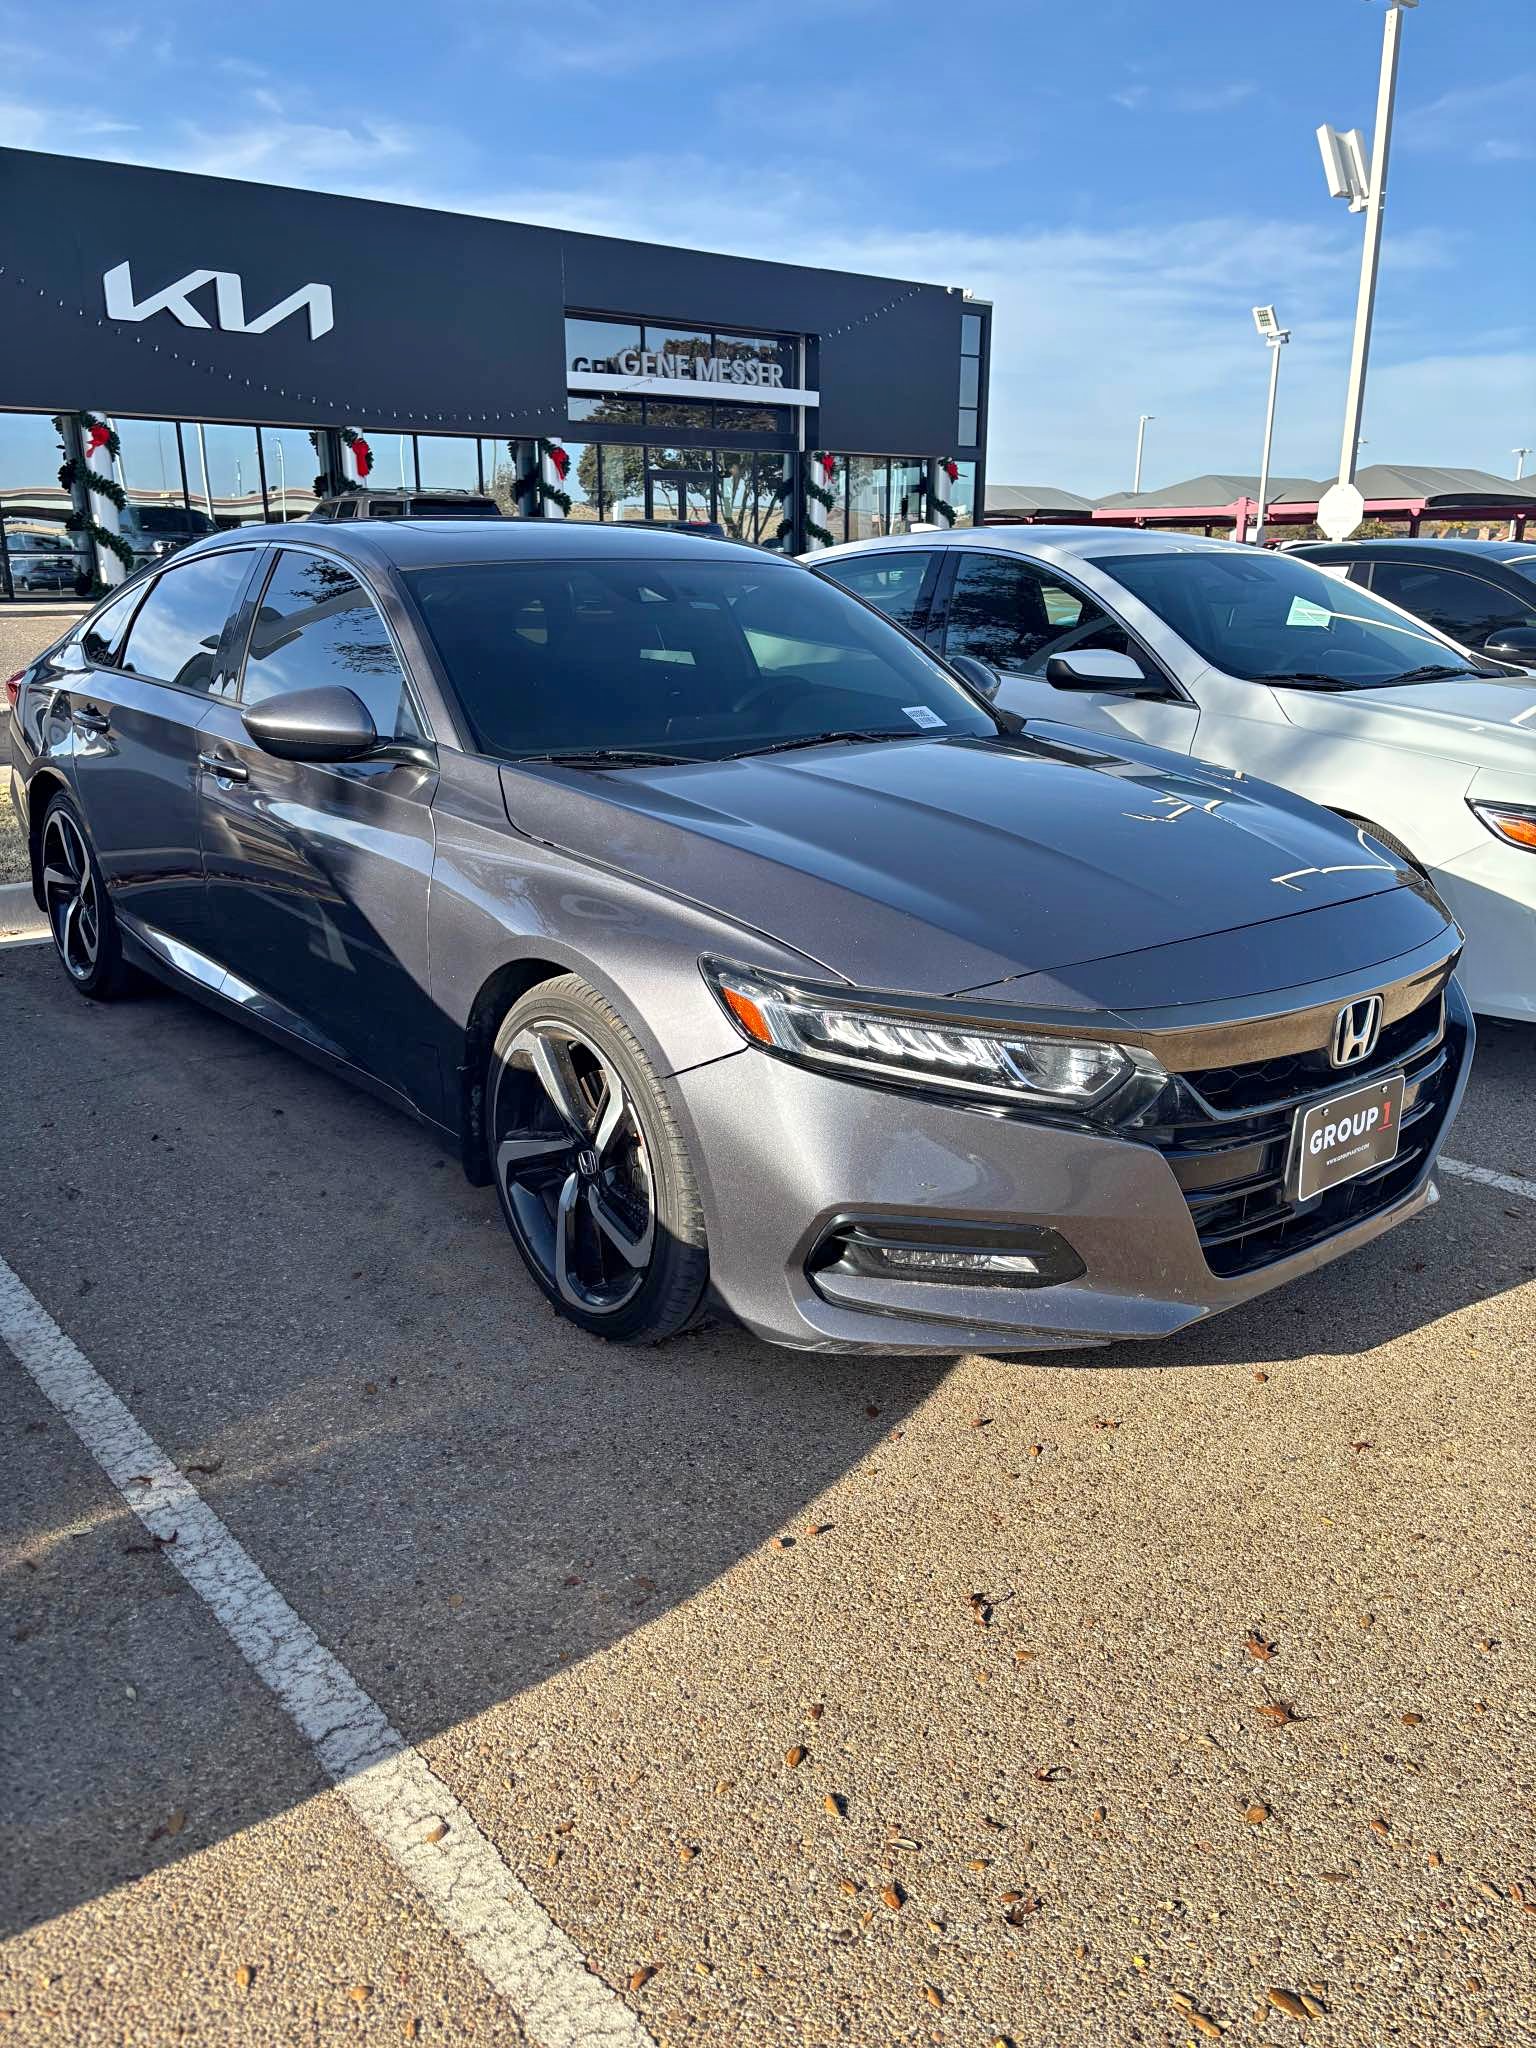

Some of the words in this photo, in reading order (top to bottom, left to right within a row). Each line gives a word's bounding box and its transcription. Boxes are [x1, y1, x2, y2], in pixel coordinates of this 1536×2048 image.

[103, 260, 334, 341] KIA
[618, 348, 691, 380] GENE
[695, 356, 784, 388] MESSER
[1309, 1106, 1379, 1155] GROUP
